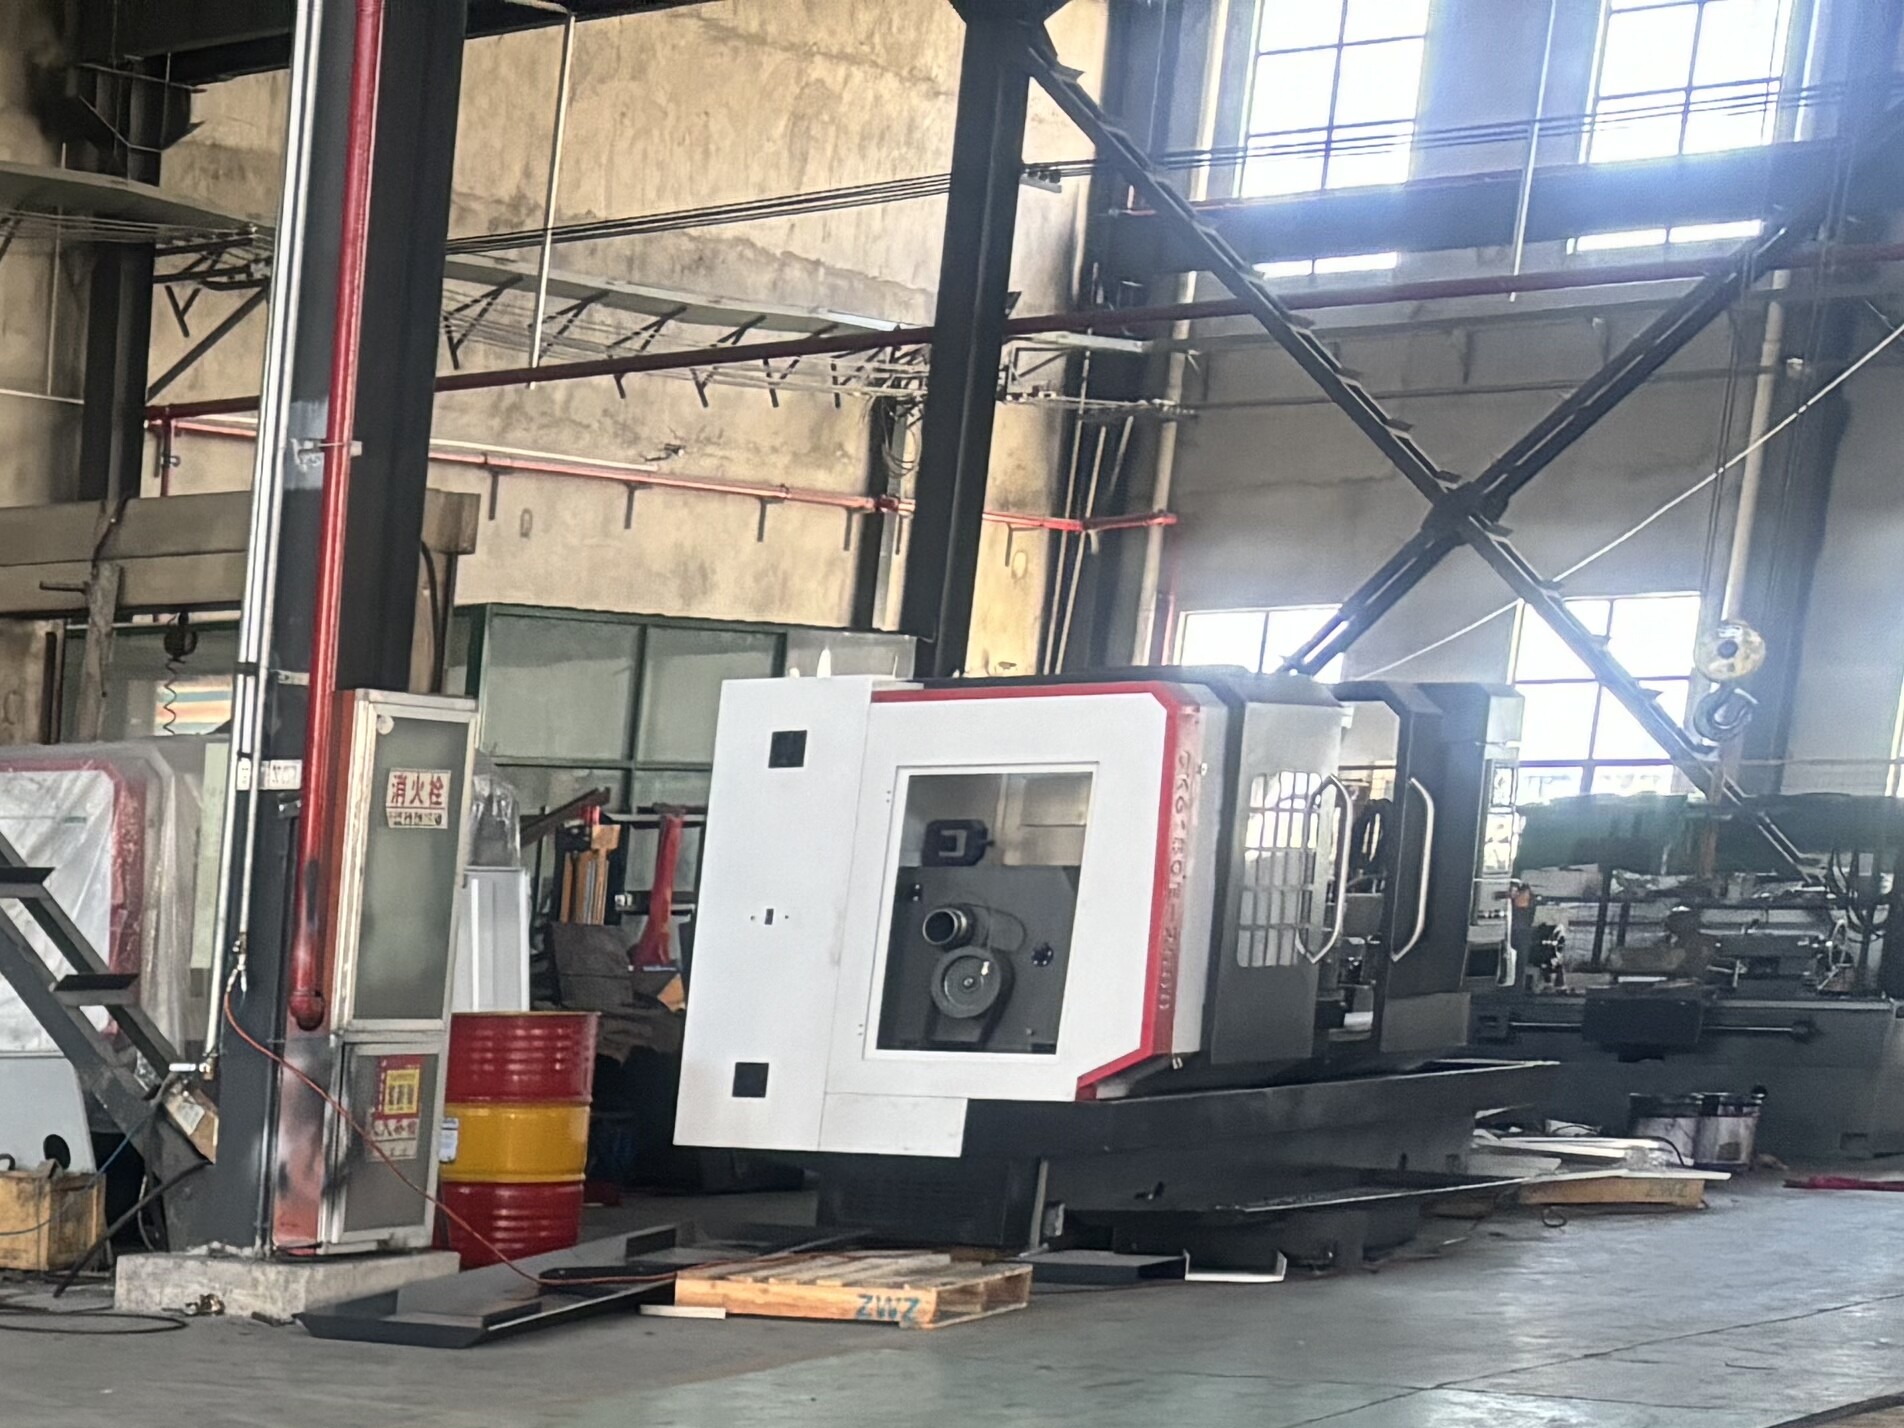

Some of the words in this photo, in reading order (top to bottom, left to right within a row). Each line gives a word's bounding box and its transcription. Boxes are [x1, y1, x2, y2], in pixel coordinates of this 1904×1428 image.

[392, 774, 445, 806] 消火栓
[855, 1294, 921, 1322] ZWZ
